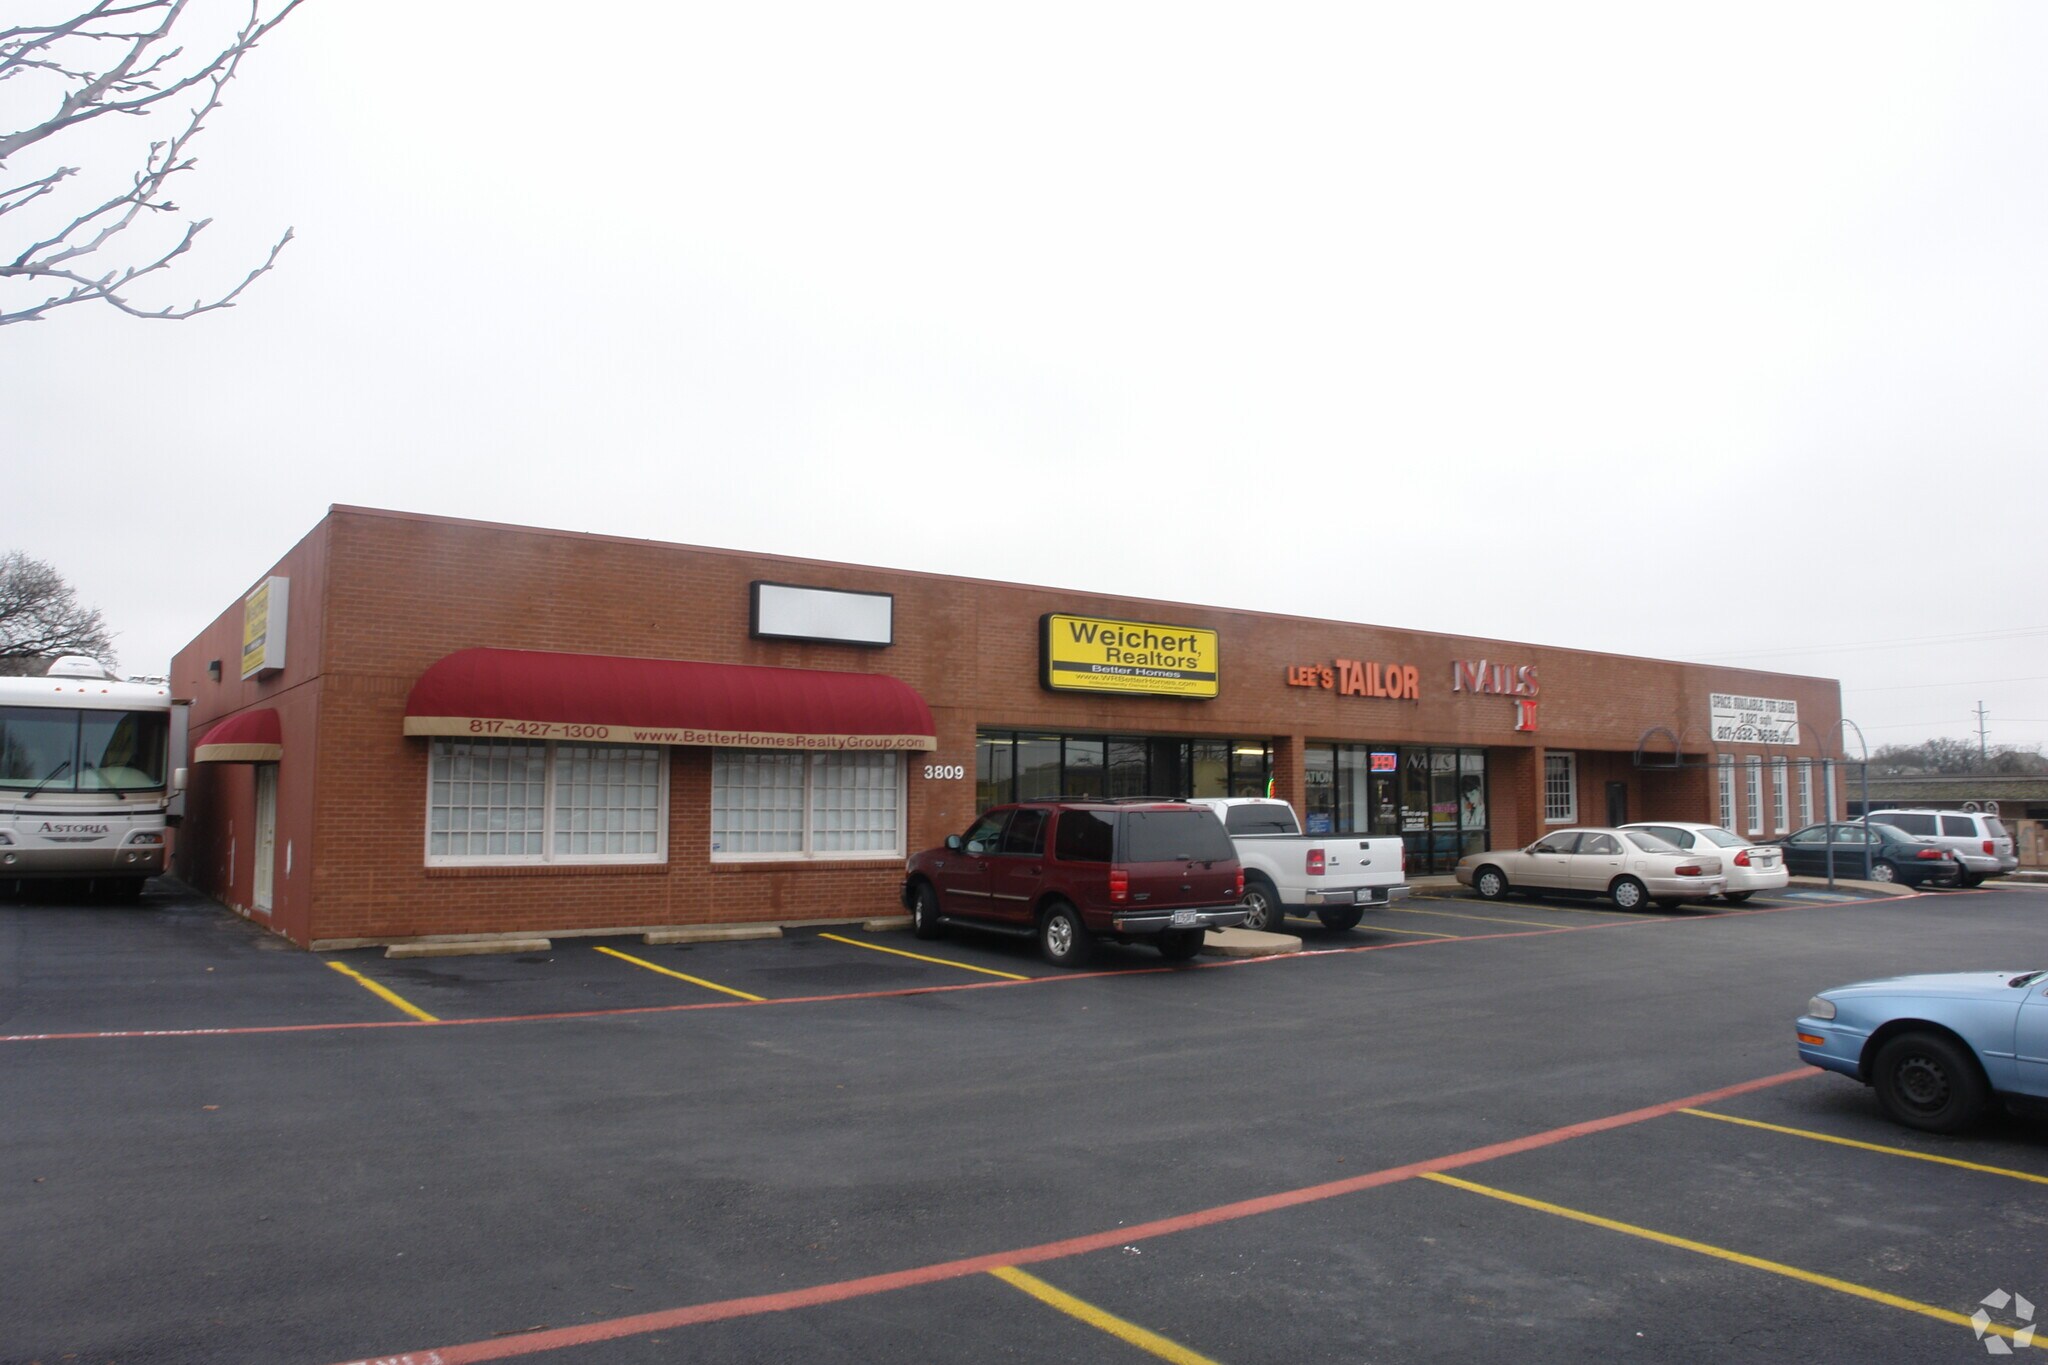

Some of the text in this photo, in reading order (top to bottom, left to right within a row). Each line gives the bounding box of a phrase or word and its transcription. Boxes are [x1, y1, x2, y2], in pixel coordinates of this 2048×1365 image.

[1069, 621, 1202, 657] Weichert,
[1106, 647, 1198, 669] Realtors
[1092, 664, 1181, 679] Better Homes
[1287, 659, 1420, 699] LEE'S TAILOR
[1452, 659, 1540, 697] NAILS
[1712, 694, 1796, 715] SPACE AVAILABLE FOR LEASE
[469, 719, 926, 749] 817-427-1300 www.BetterHomesRealtyGroup.com
[924, 765, 965, 780] 3809
[1370, 754, 1396, 770] OPEN
[38, 821, 110, 834] ASTORIA
